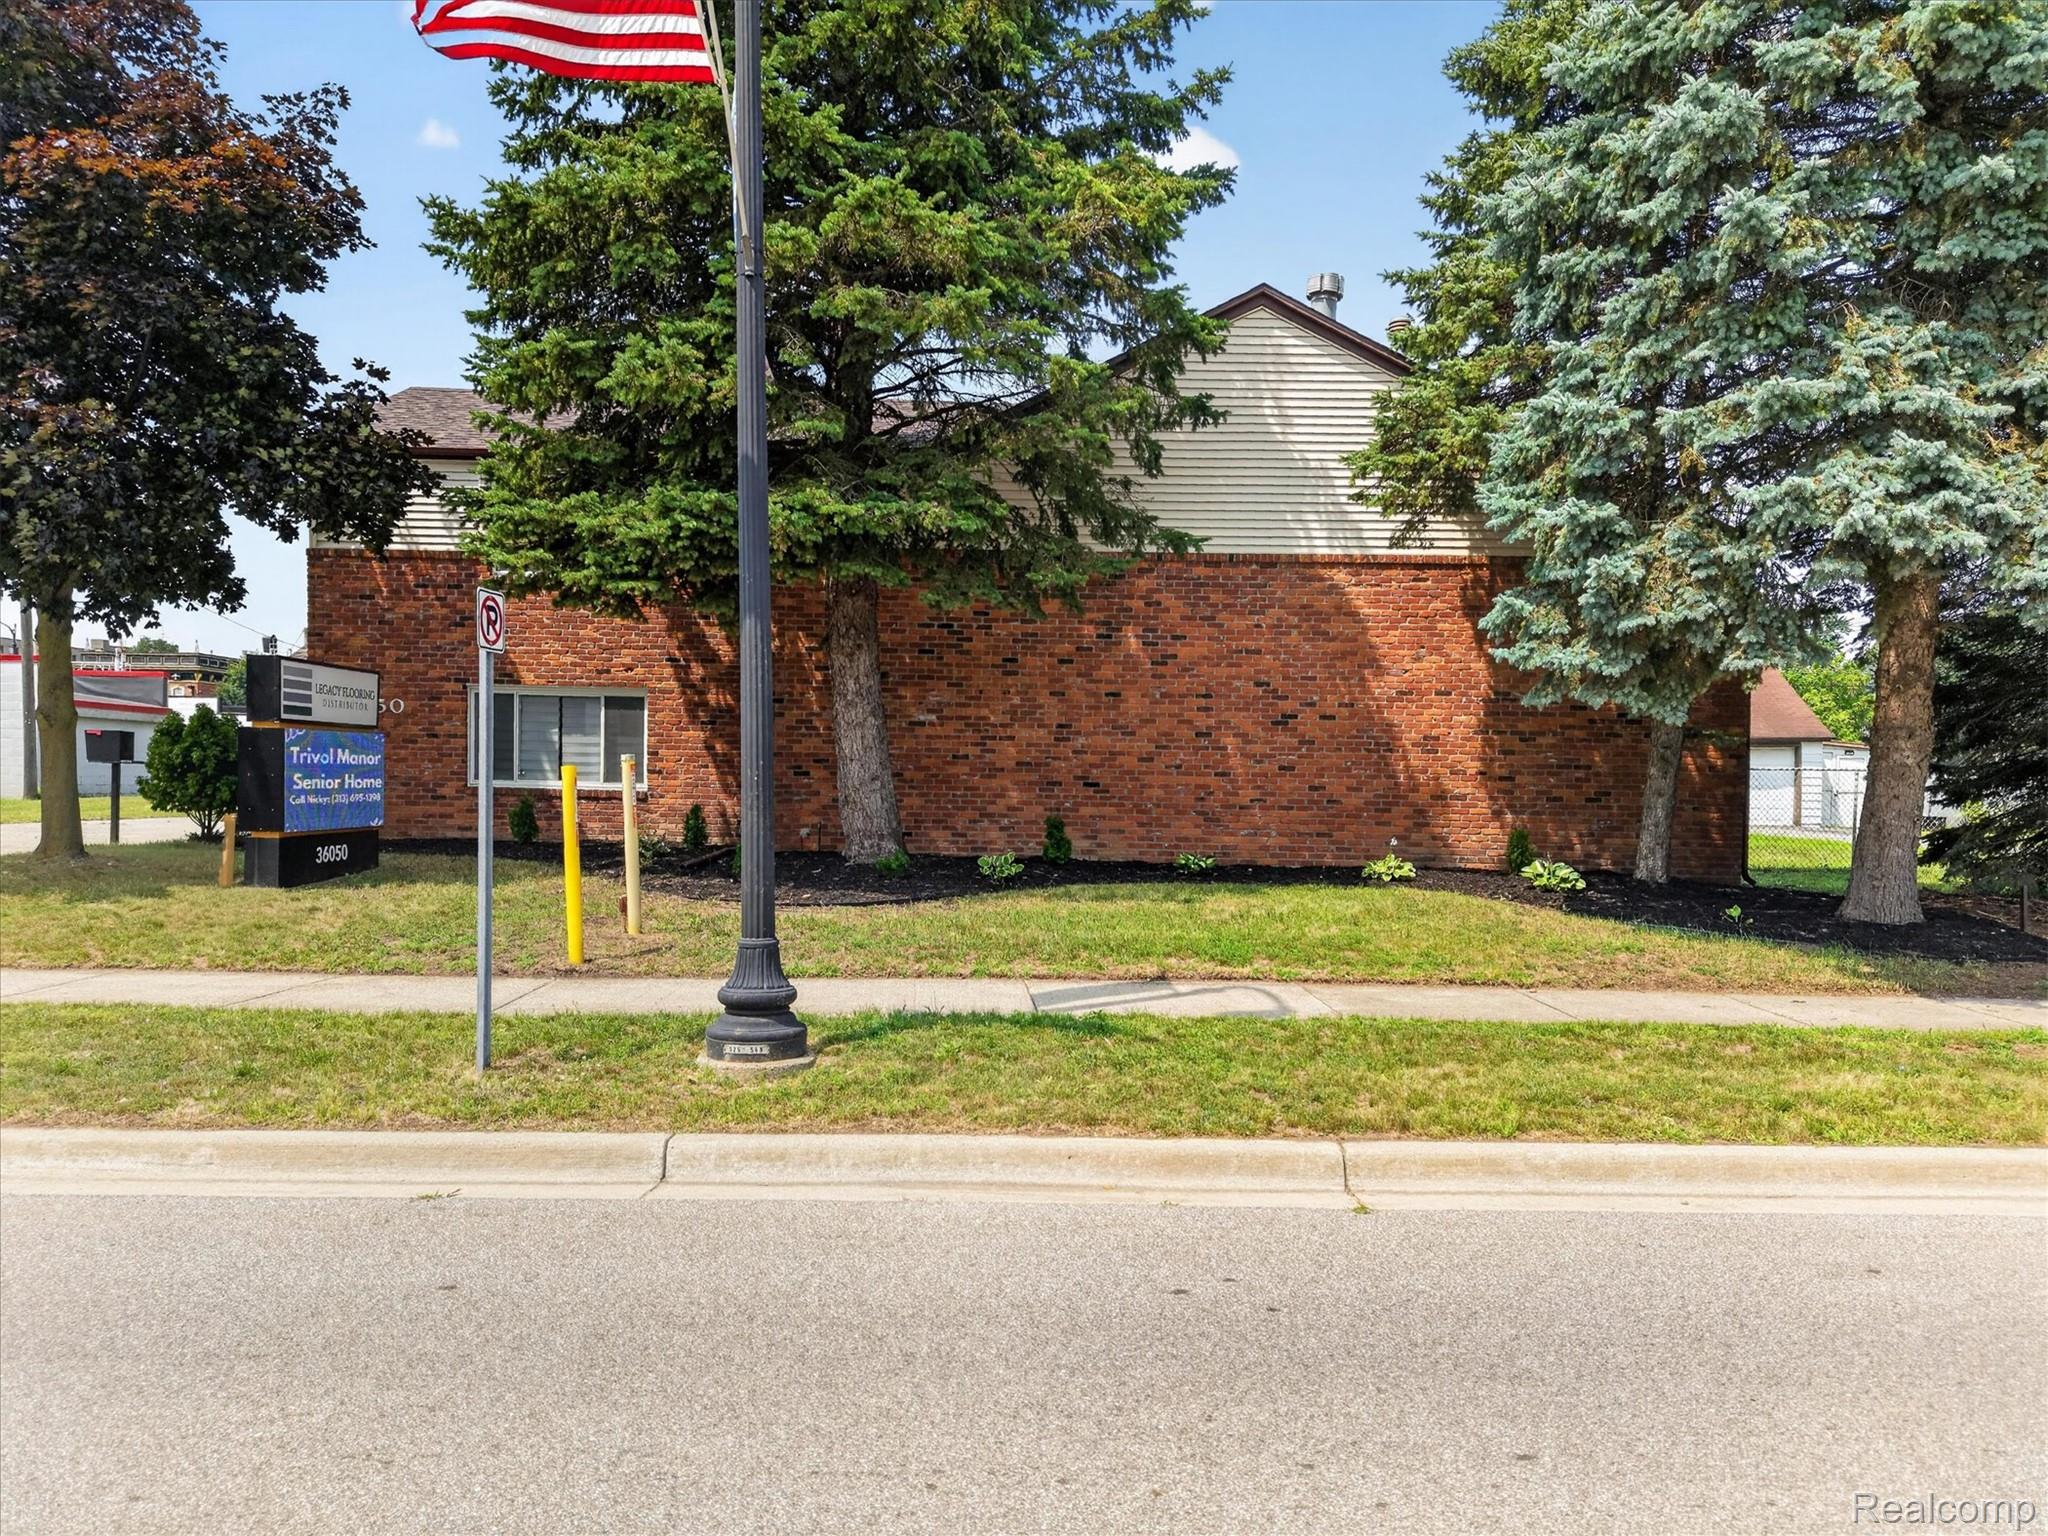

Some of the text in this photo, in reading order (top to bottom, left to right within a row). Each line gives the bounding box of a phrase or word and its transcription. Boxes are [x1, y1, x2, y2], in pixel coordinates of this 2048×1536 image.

[315, 683, 376, 701] LEGACY FLOORING
[322, 699, 369, 712] DISTRIBUTOR
[290, 746, 381, 765] Trivol Manor
[292, 773, 382, 790] Senior Home
[289, 795, 306, 805] Call
[315, 844, 348, 864] 36050
